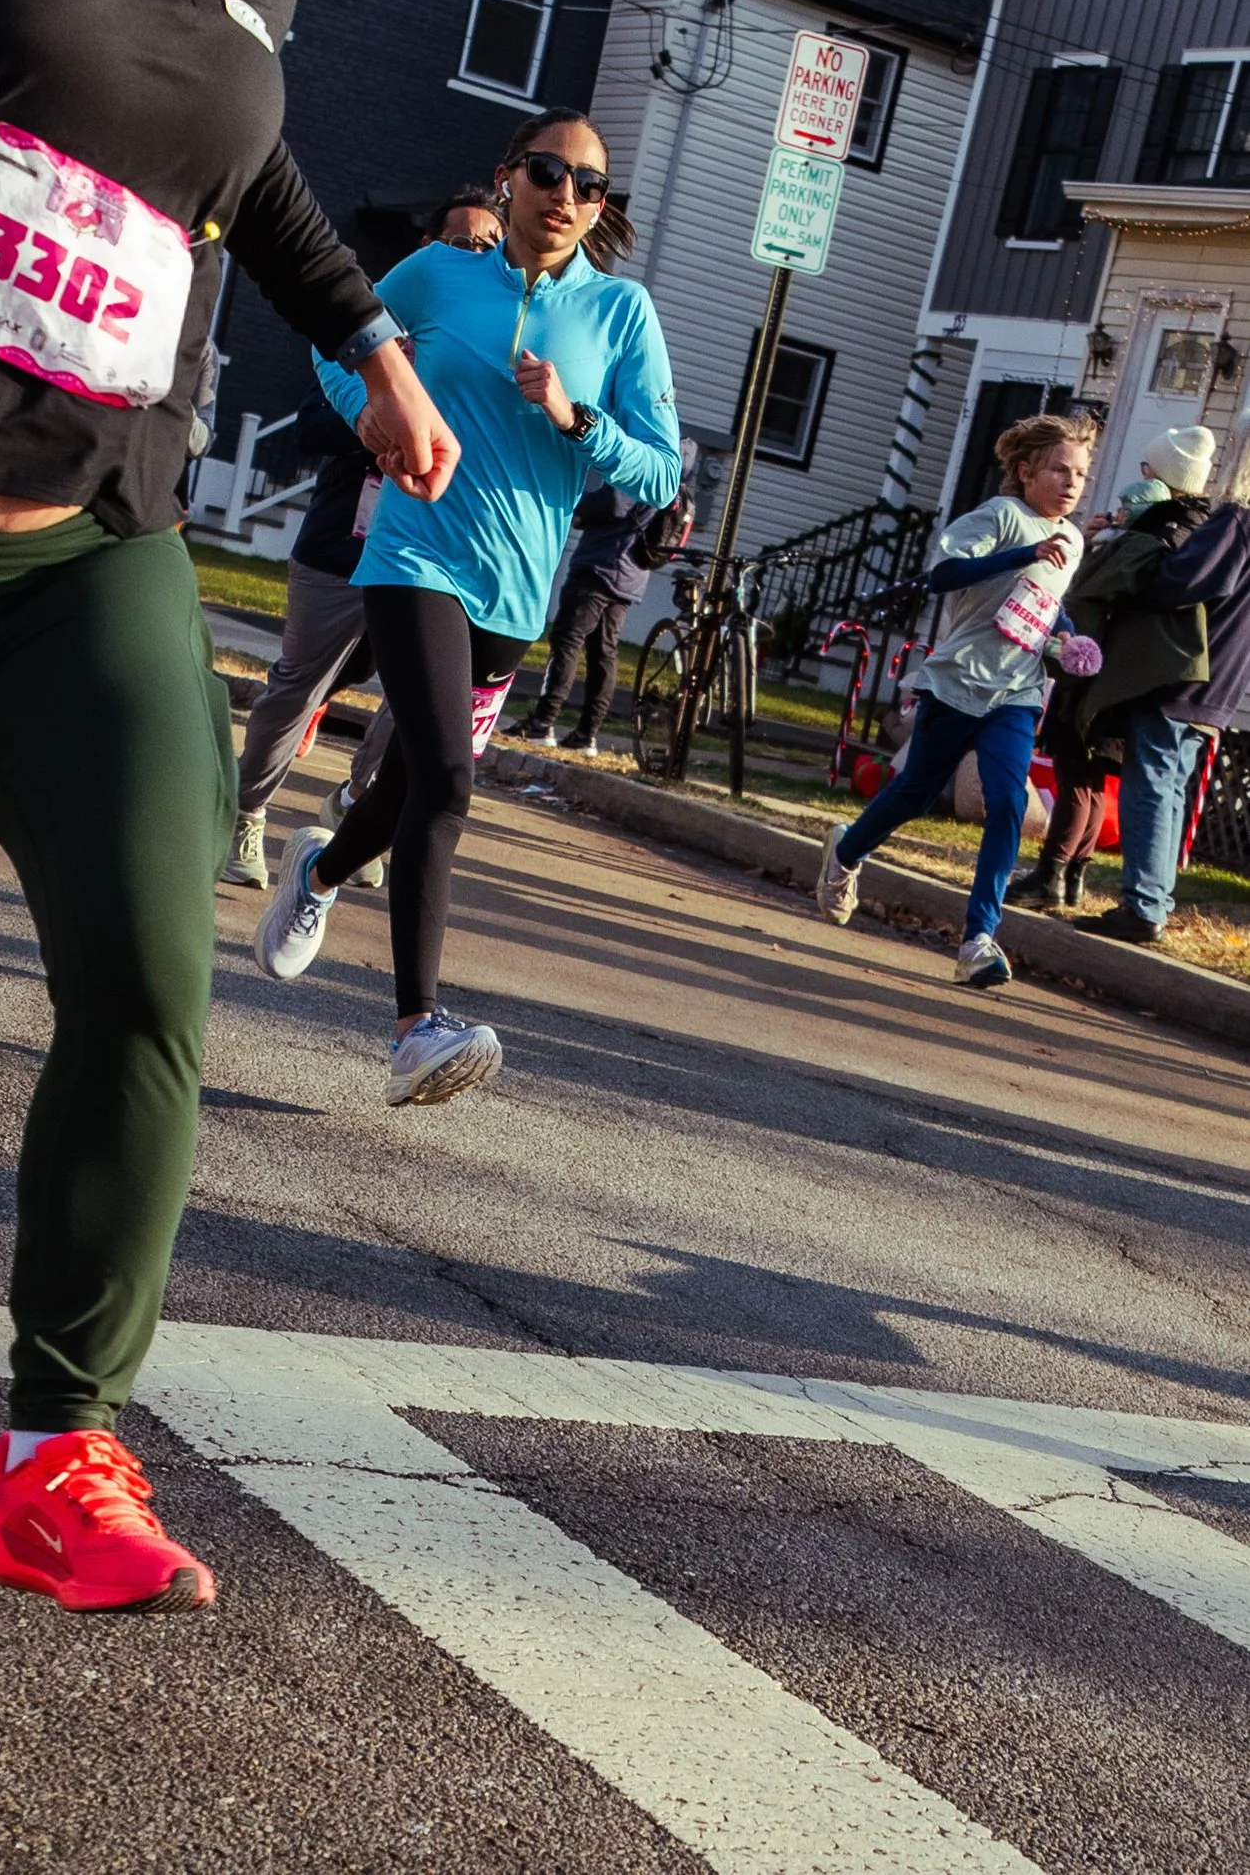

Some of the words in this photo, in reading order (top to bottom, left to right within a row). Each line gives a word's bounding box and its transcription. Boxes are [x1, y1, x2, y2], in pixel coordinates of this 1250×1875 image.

[815, 47, 842, 73] NO
[793, 66, 856, 101] PARKING
[792, 90, 829, 113] HERE
[832, 100, 848, 118] TO
[790, 108, 844, 135] CORNER
[778, 159, 833, 188] PERMIT
[769, 178, 832, 210] PARKING
[778, 203, 815, 227] ONLY
